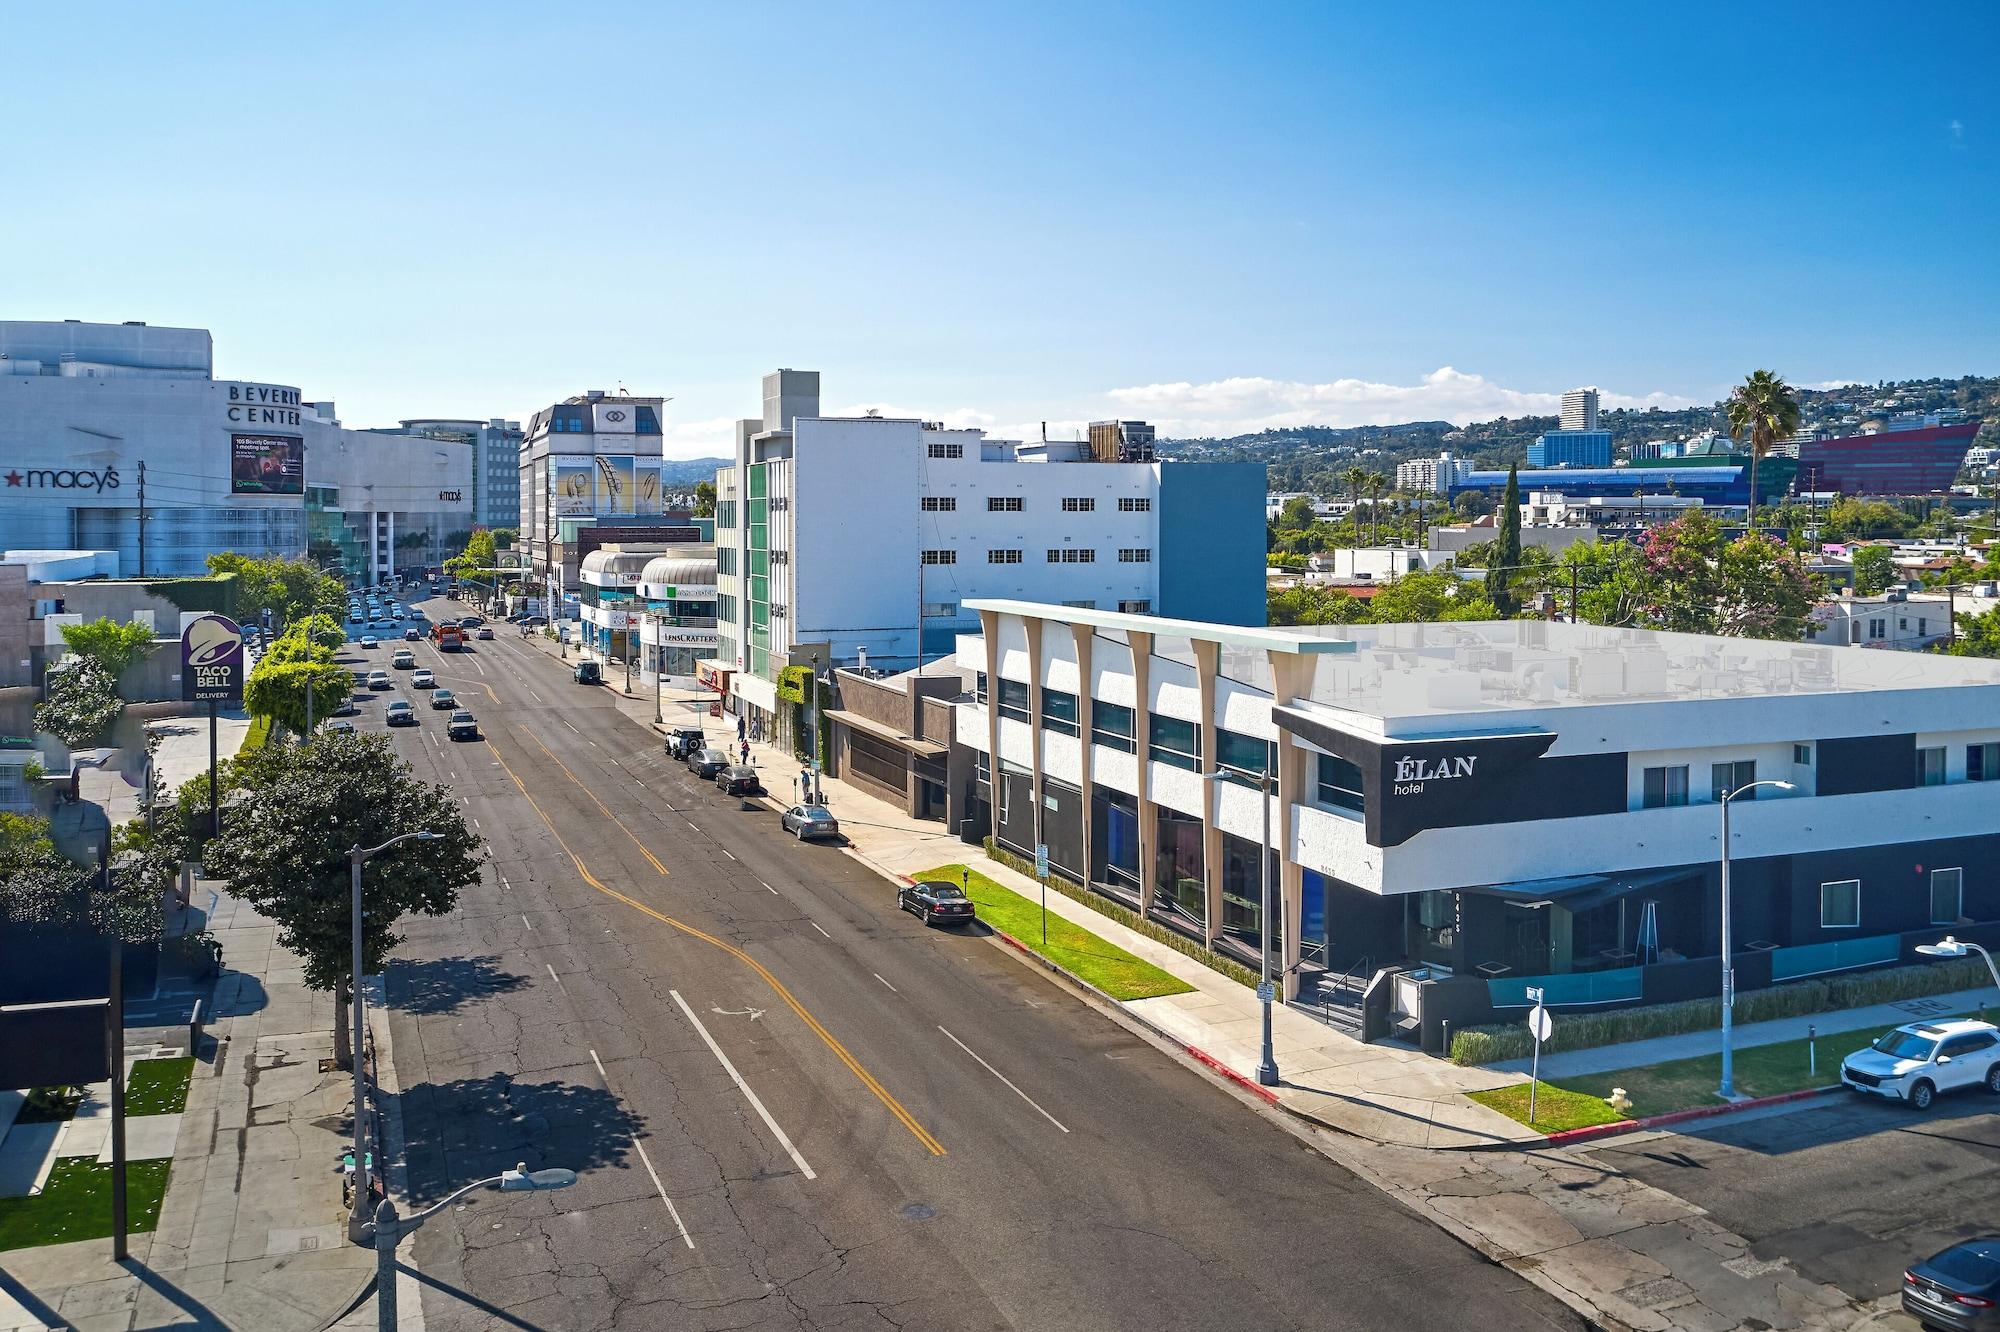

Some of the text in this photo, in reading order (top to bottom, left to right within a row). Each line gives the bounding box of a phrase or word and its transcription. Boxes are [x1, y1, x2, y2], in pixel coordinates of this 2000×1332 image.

[230, 386, 300, 405] BEVERLY
[228, 407, 300, 426] CENTER
[27, 465, 120, 495] macy's
[443, 489, 462, 505] macy's
[194, 665, 232, 677] TACO
[197, 676, 231, 688] BELL
[1393, 755, 1478, 782] ÉLAN
[1394, 782, 1424, 796] hotel
